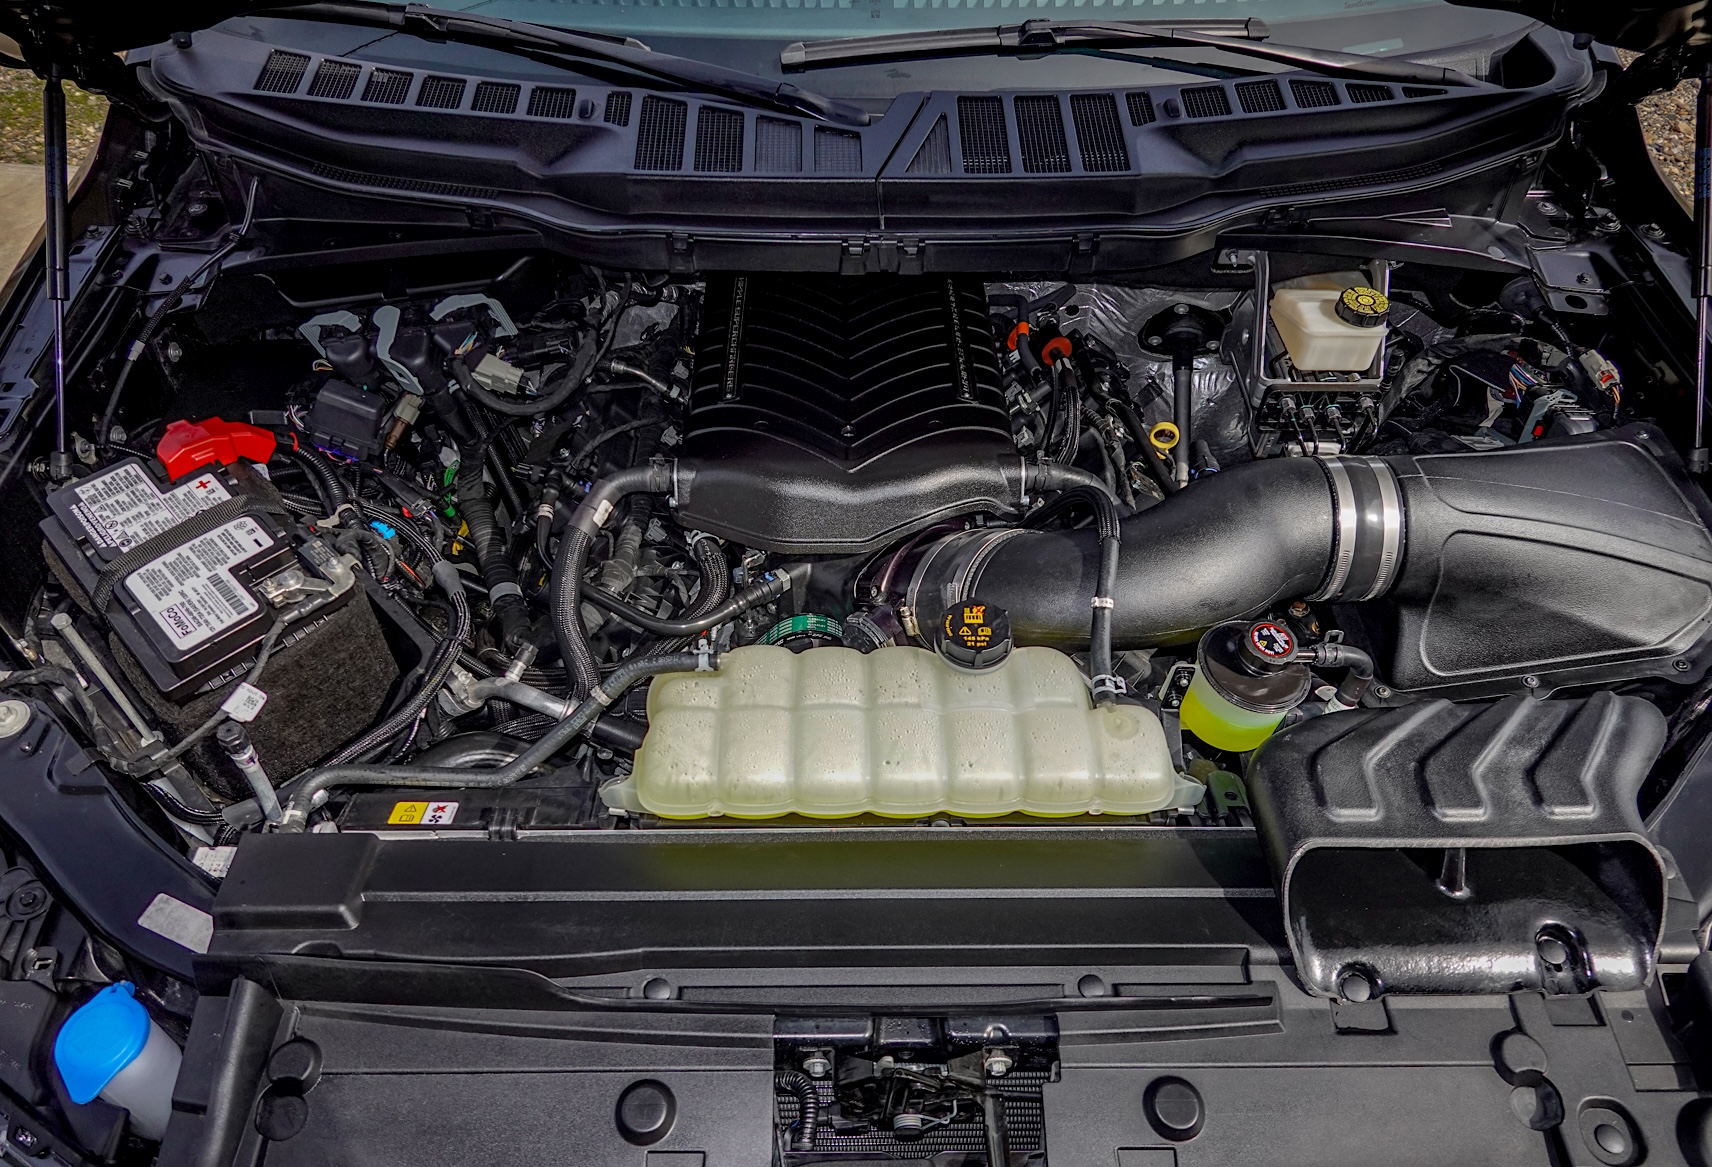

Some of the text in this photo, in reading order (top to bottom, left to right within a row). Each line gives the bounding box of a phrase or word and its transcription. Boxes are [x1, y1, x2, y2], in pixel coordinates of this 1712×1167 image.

[71, 508, 104, 544] DANGER POISON
[93, 523, 114, 544] PELIGRO
[167, 607, 192, 636] FoMoCo
